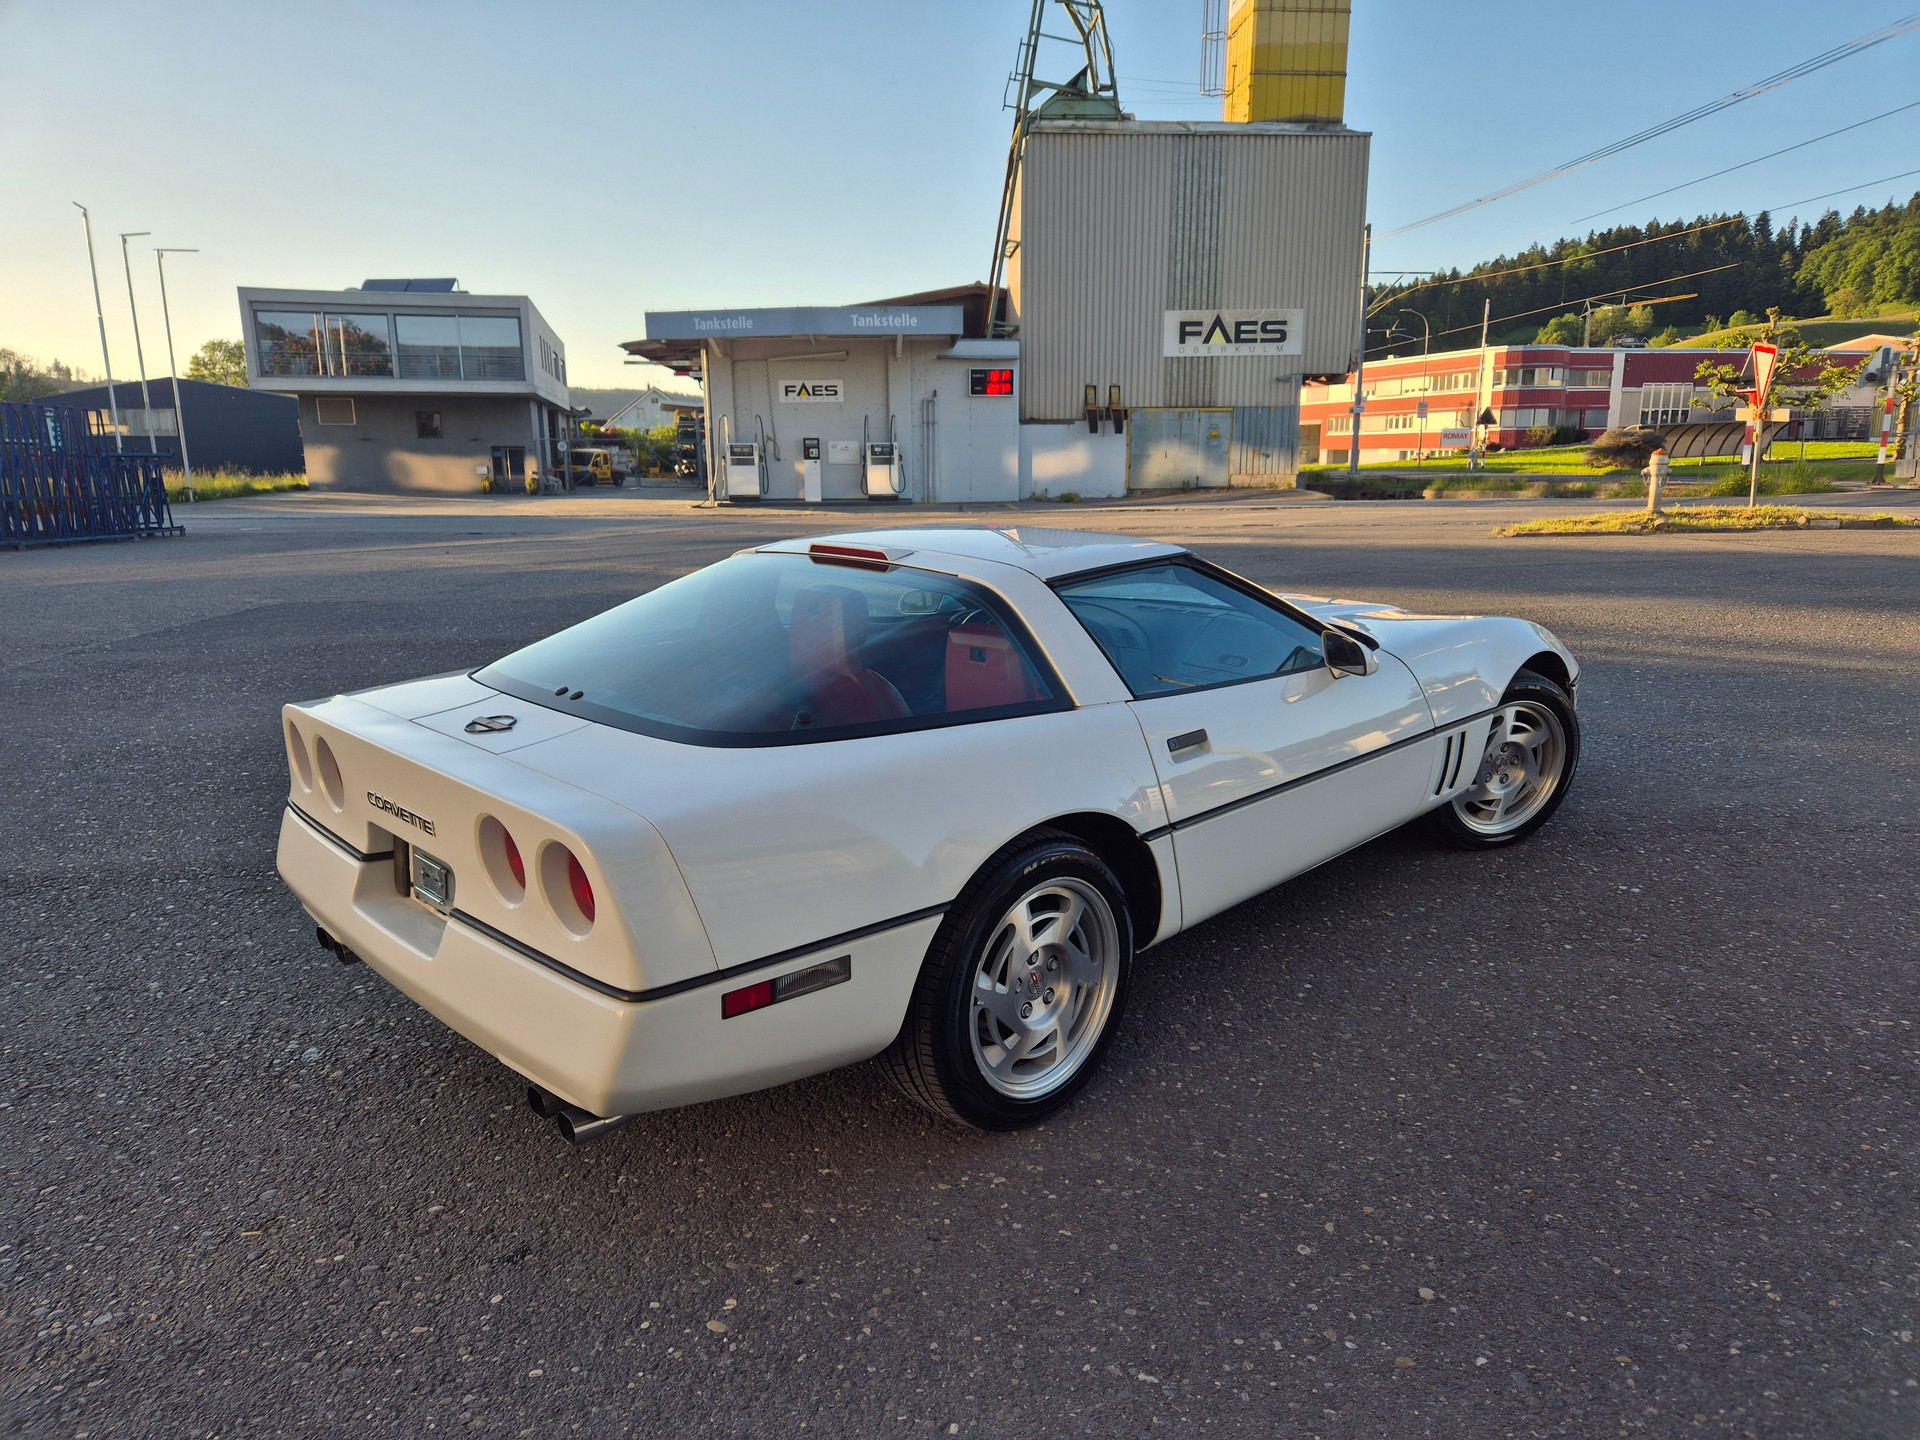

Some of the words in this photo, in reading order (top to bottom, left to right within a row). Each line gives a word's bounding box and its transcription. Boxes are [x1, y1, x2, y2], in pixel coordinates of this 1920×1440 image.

[693, 316, 753, 331] Tankstelle
[851, 313, 918, 327] Tankstelle
[1179, 313, 1287, 344] FAES
[1178, 345, 1284, 354] OBERKULM
[784, 382, 838, 397] FAES
[1443, 432, 1469, 440] ROMAY
[367, 789, 436, 837] CORVETTE
